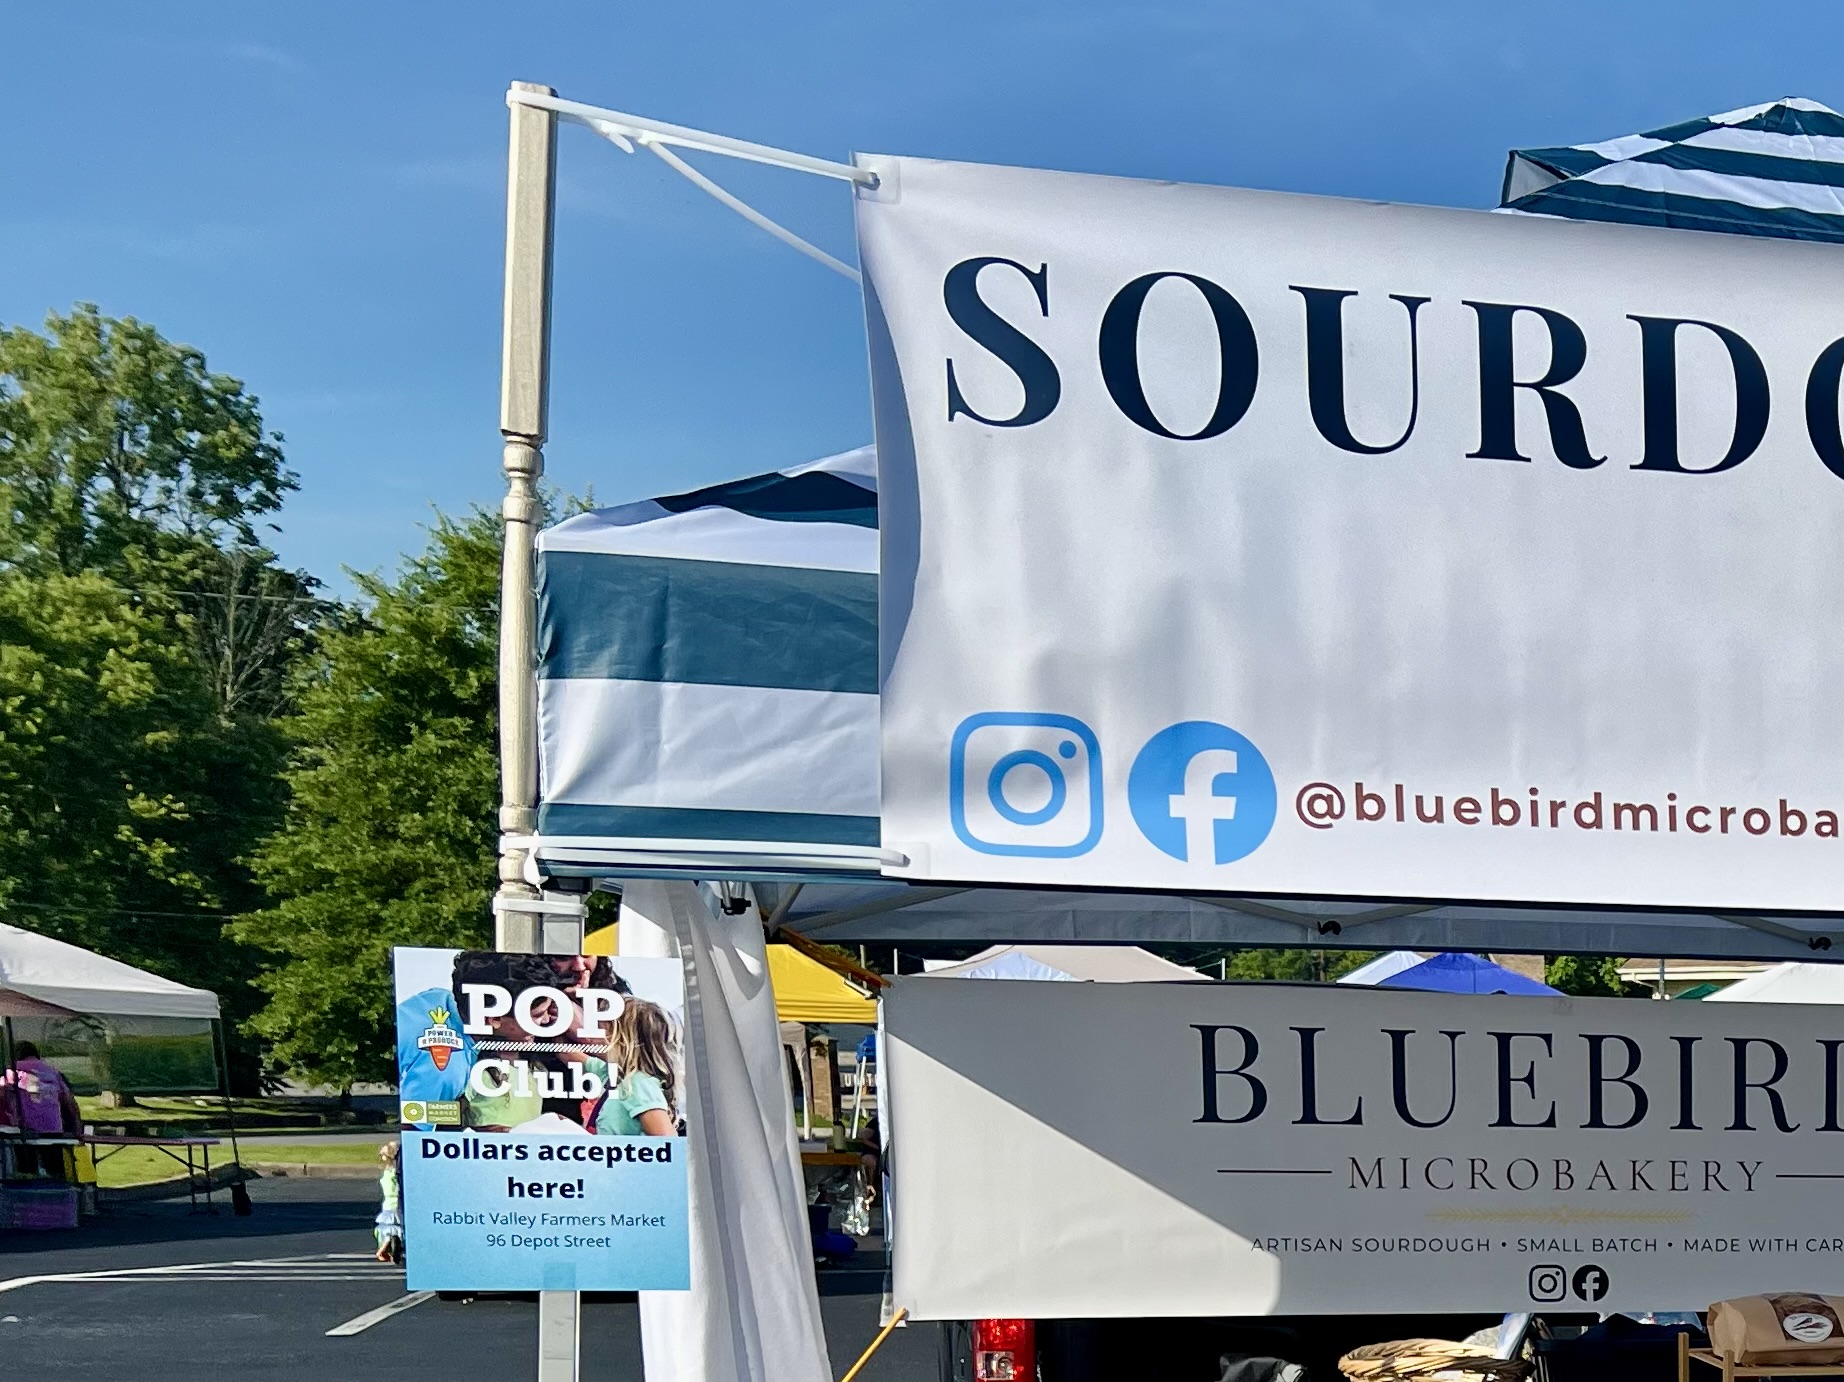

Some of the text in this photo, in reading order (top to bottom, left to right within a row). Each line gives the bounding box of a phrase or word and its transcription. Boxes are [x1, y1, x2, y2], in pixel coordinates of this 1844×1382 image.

[461, 983, 625, 1039] POP
[470, 1059, 620, 1100] Club!
[421, 1138, 672, 1168] Dollars accepted
[1347, 1157, 1765, 1192] MICROBAKERY
[507, 1177, 585, 1199] here!
[433, 1211, 666, 1229] Rabbit Valley Farmers Market
[486, 1235, 611, 1250] 96 Depot Street
[1250, 1237, 1344, 1252] ARTISAN
[1351, 1238, 1490, 1253] SOURDOUGH
[1516, 1238, 1585, 1253] SMALL
[1592, 1238, 1658, 1253] BATCH
[1684, 1238, 1741, 1253] MADE
[1745, 1238, 1802, 1253] WITH
